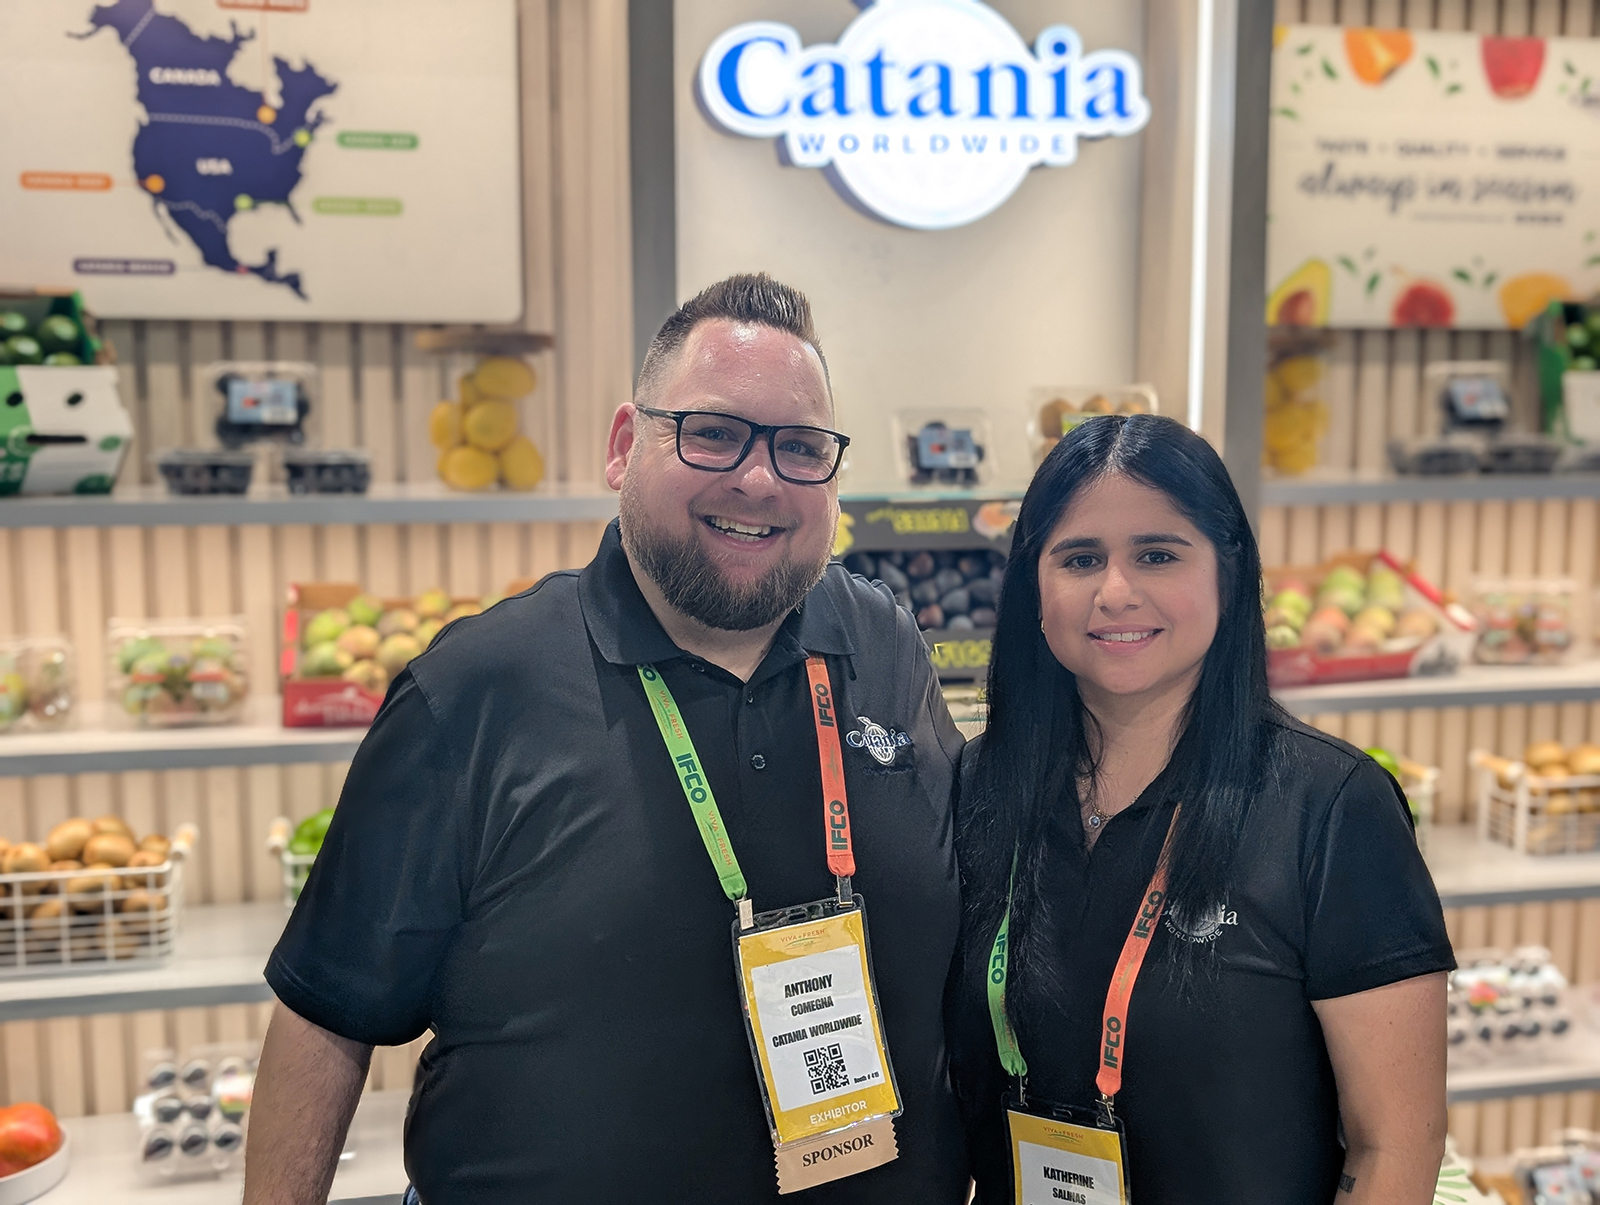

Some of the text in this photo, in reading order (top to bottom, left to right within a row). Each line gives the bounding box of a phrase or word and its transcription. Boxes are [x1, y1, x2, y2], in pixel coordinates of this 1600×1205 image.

[149, 66, 221, 86] CANADA
[717, 36, 1133, 120] Catania
[798, 133, 1068, 154] WORLDWIDE
[196, 158, 233, 175] USA
[660, 690, 683, 740] VIVA FRESH
[815, 683, 834, 727] IFCO
[675, 753, 708, 804] IFCO
[708, 810, 733, 866] VIVA FRESH
[829, 800, 849, 850] IFCO
[1133, 890, 1163, 939] IFCO
[780, 928, 826, 943] VIVA FRESH
[1164, 919, 1224, 944] WORLDWIDE
[991, 933, 1006, 985] IFCO
[784, 974, 833, 998] ANTHONY
[791, 996, 834, 1017] COMEGNA
[772, 1014, 863, 1048] CATANIA WORLDWIDE
[1103, 1016, 1121, 1069] IFCO
[809, 1100, 867, 1125] EXHIBITOR
[1043, 1126, 1058, 1134] VIVA
[802, 1133, 875, 1167] SPONSOR
[1043, 1166, 1095, 1189] KATHERINE
[1052, 1187, 1087, 1205] SALINAS
